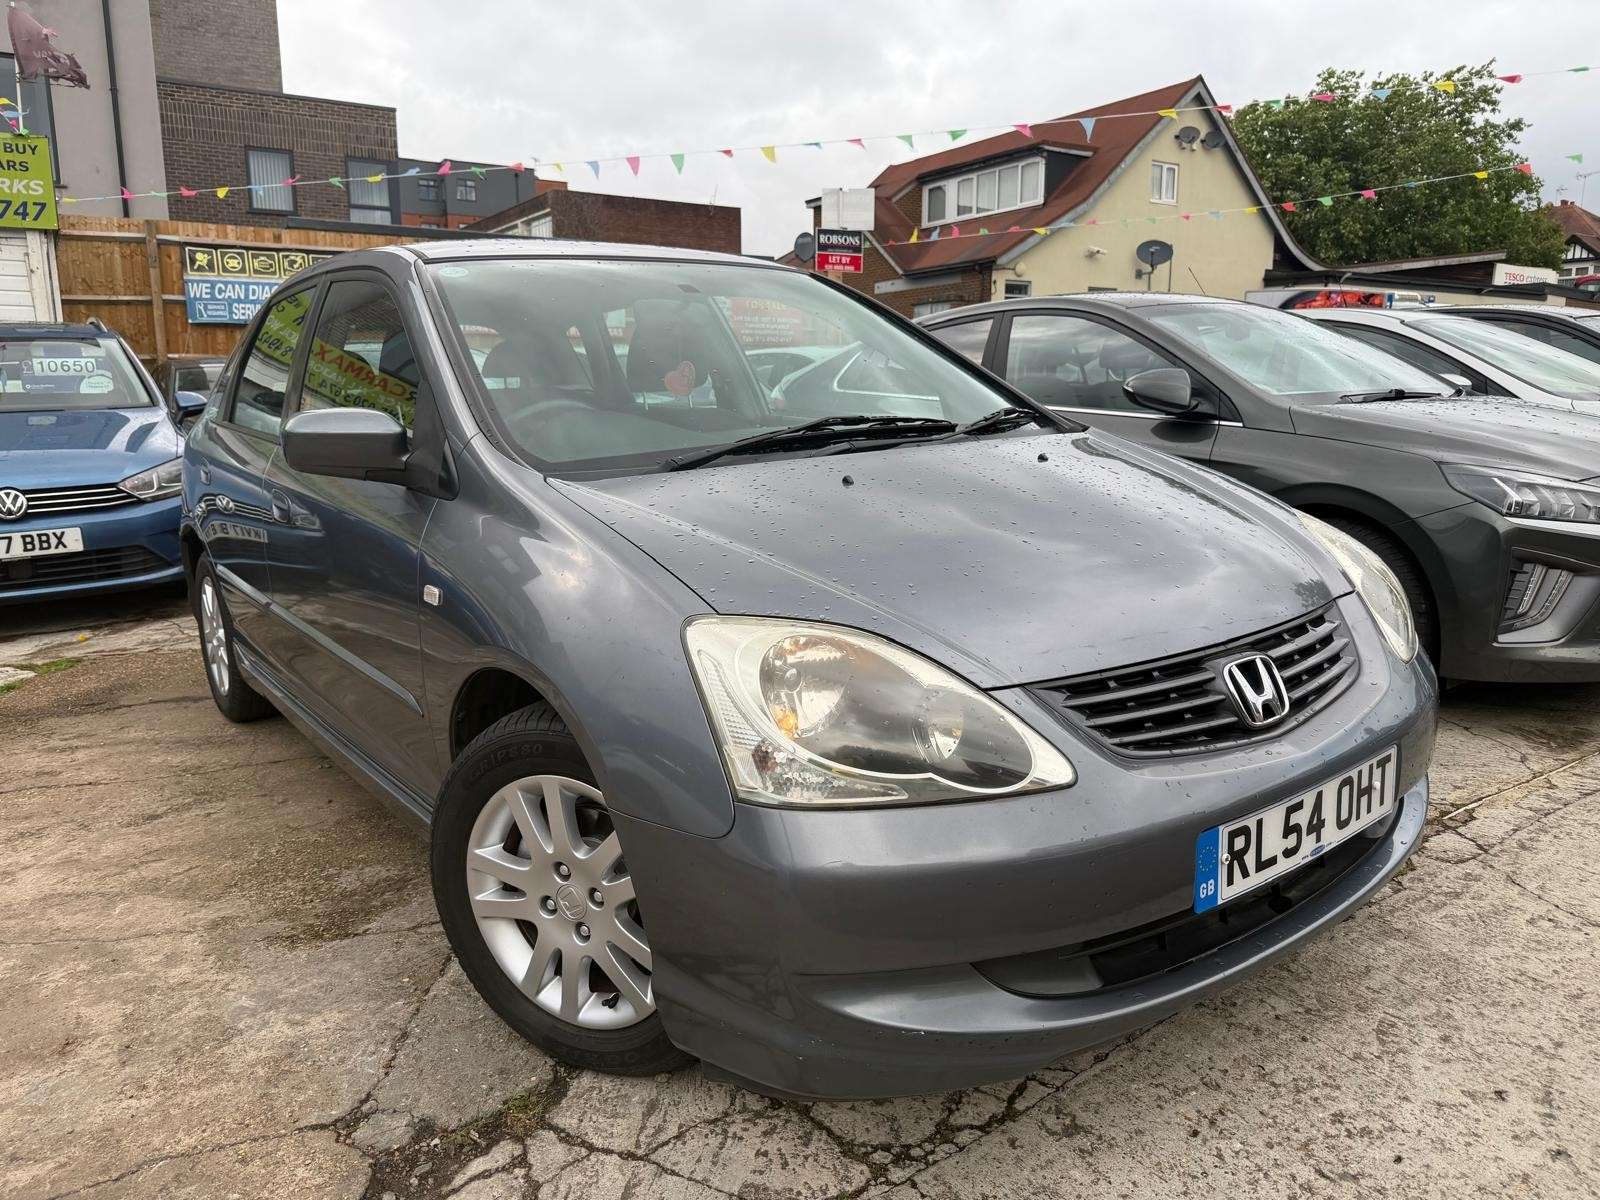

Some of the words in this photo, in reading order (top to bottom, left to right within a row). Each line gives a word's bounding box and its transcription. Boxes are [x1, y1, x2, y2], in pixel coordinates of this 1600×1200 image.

[3, 142, 38, 155] BUY
[0, 200, 47, 221] 747
[819, 233, 861, 246] ROBSONS
[828, 255, 840, 264] LET
[841, 256, 851, 265] BY
[1504, 272, 1525, 282] TESCO
[188, 282, 211, 299] WE
[214, 283, 245, 300] CAN
[21, 531, 67, 552] BBX
[1226, 789, 1326, 887] RL54
[1336, 753, 1392, 831] OHT
[1199, 879, 1215, 898] GB
